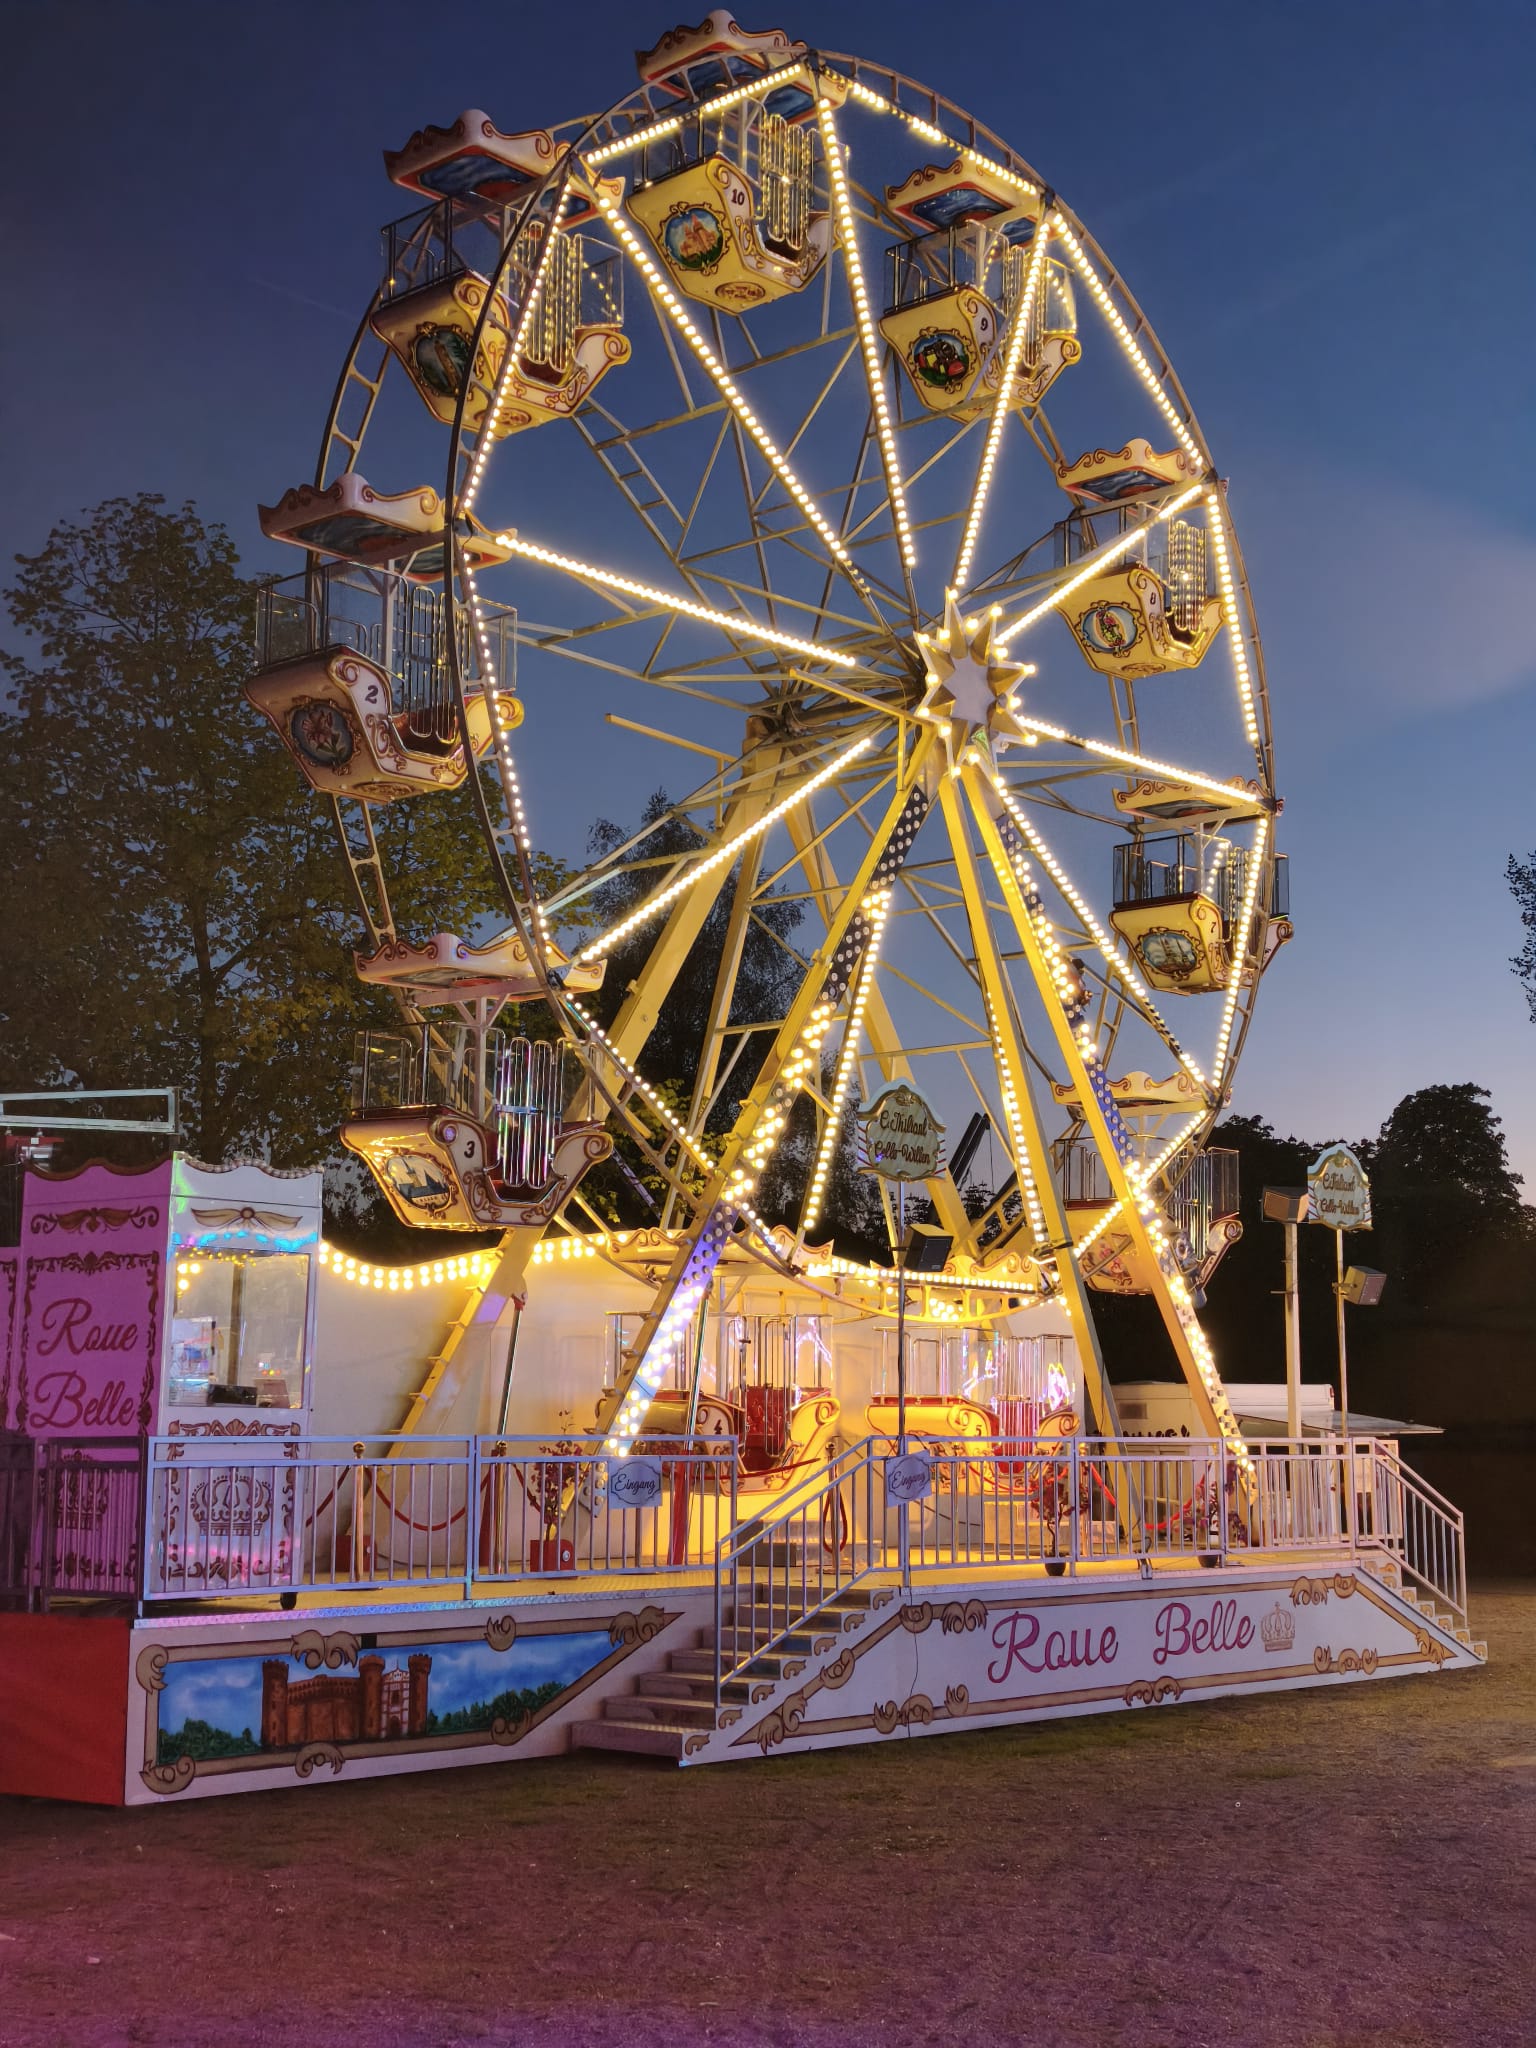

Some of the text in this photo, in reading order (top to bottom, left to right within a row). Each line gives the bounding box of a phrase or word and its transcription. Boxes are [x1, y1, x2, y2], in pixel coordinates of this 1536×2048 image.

[731, 189, 745, 205] 10
[980, 317, 988, 331] 9
[1150, 592, 1156, 605] 8
[367, 685, 379, 704] 2
[1210, 921, 1217, 934] 7
[464, 1141, 475, 1158] 3
[36, 1298, 138, 1356] Roue
[29, 1370, 135, 1428] Belle
[975, 1424, 982, 1436] 5
[614, 1474, 656, 1495] Eingang
[892, 1471, 926, 1489] Eingang
[987, 1598, 1256, 1684] Roue Belle
